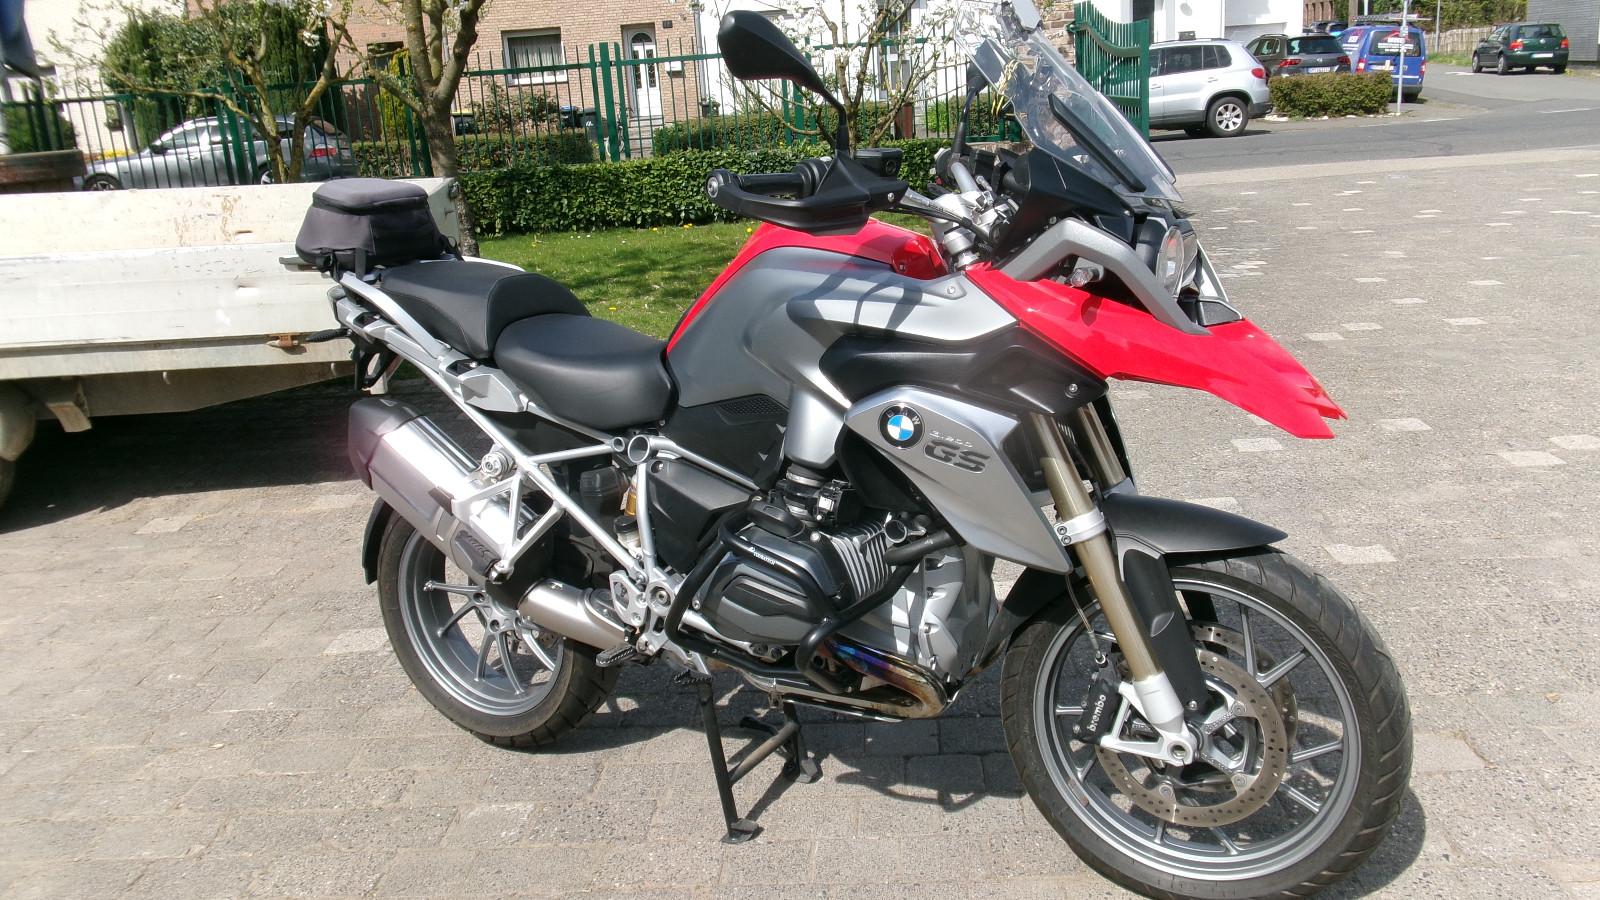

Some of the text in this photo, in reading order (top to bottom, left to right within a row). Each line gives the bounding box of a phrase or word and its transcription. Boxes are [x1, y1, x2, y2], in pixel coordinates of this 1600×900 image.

[885, 409, 920, 425] BMW
[924, 439, 990, 473] GS
[1086, 694, 1107, 732] brembo
